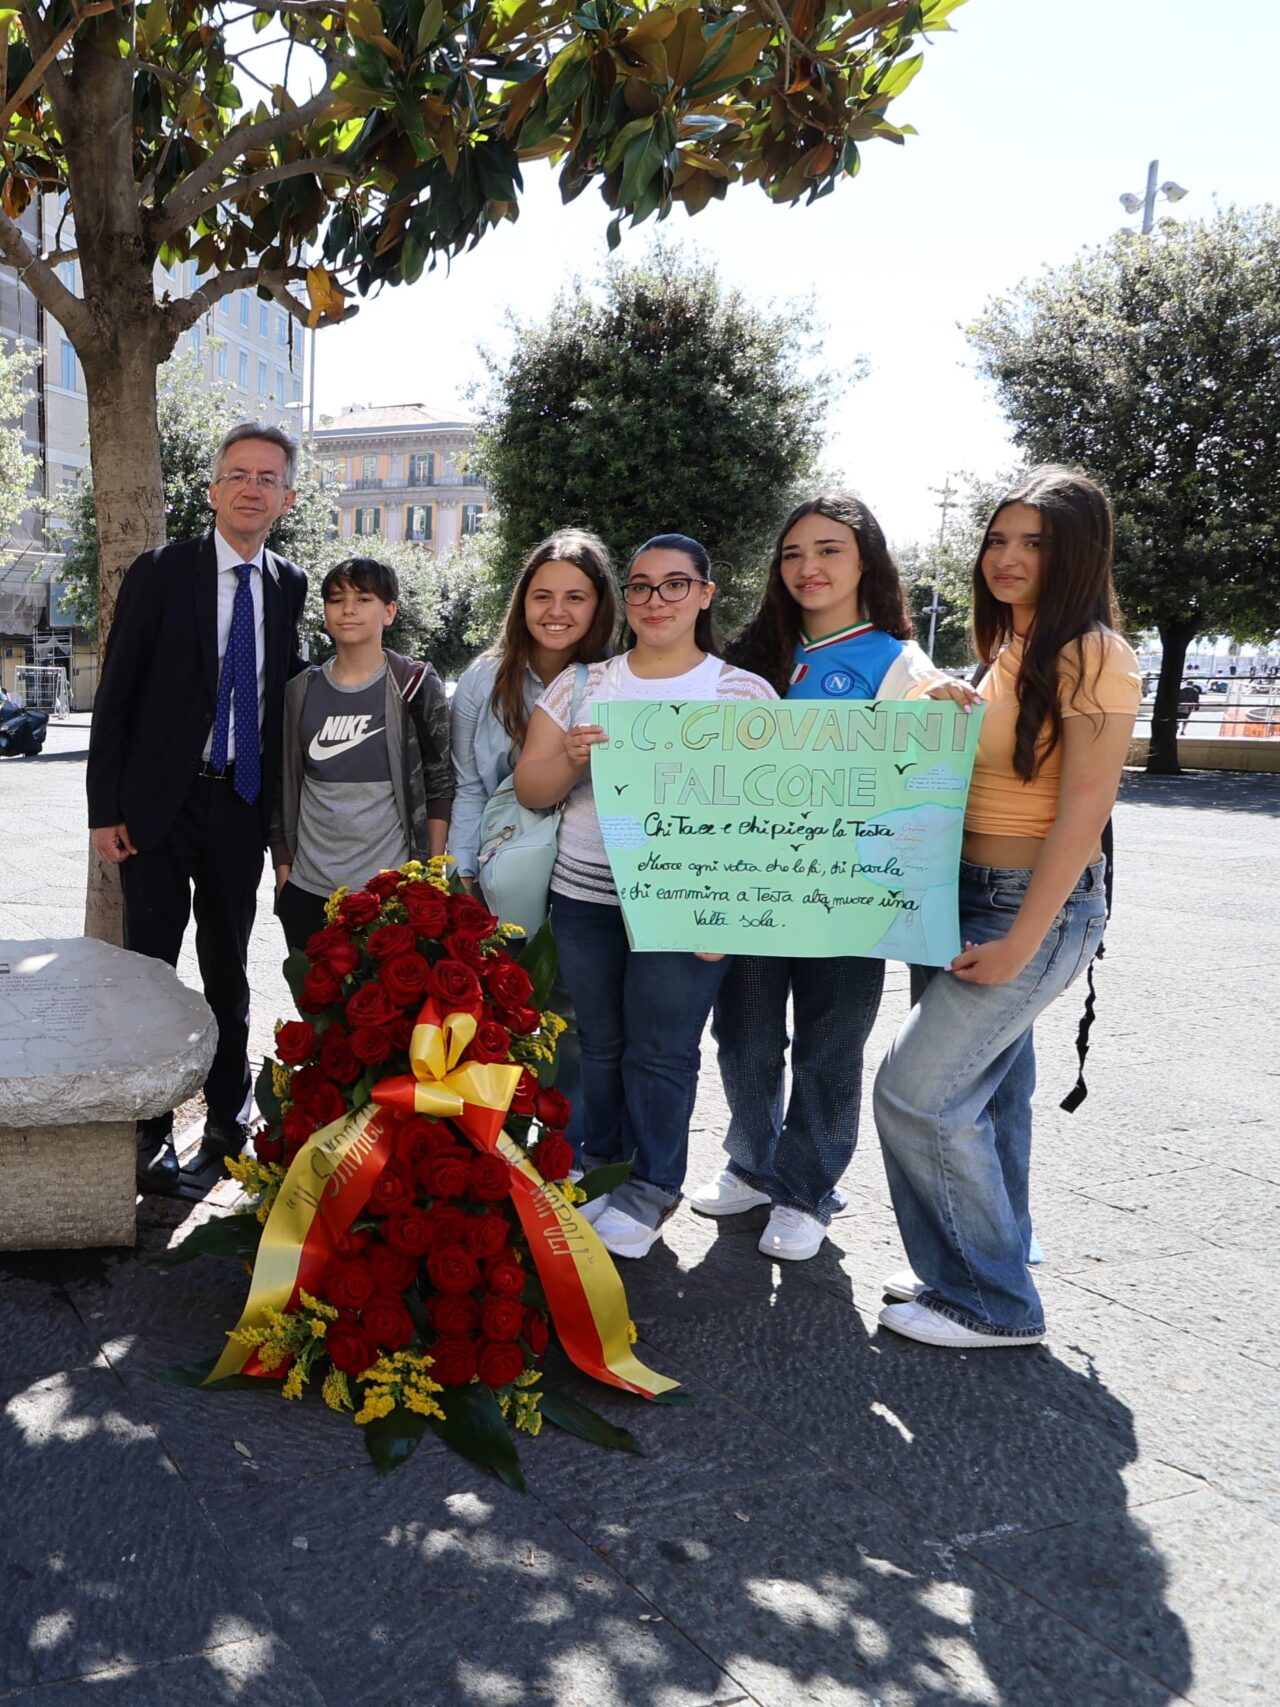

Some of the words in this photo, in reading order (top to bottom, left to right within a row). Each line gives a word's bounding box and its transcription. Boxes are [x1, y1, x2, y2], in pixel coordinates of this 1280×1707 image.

[319, 714, 372, 741] NIKE
[680, 703, 969, 752] GIOVANNI
[653, 762, 876, 807] FALCONE
[644, 811, 672, 837] Chi
[720, 823, 733, 834] e
[771, 821, 829, 841] piega
[831, 817, 848, 838] la
[637, 851, 682, 872] Muore
[688, 860, 719, 876] ogni
[724, 858, 761, 872] volta
[765, 857, 789, 873] che
[791, 857, 805, 873] lo
[830, 860, 846, 875] chi
[851, 857, 904, 877] parla
[629, 882, 651, 899] chi
[736, 891, 749, 902] a
[803, 888, 829, 905] alta
[833, 895, 875, 906] muore
[878, 894, 919, 911] una
